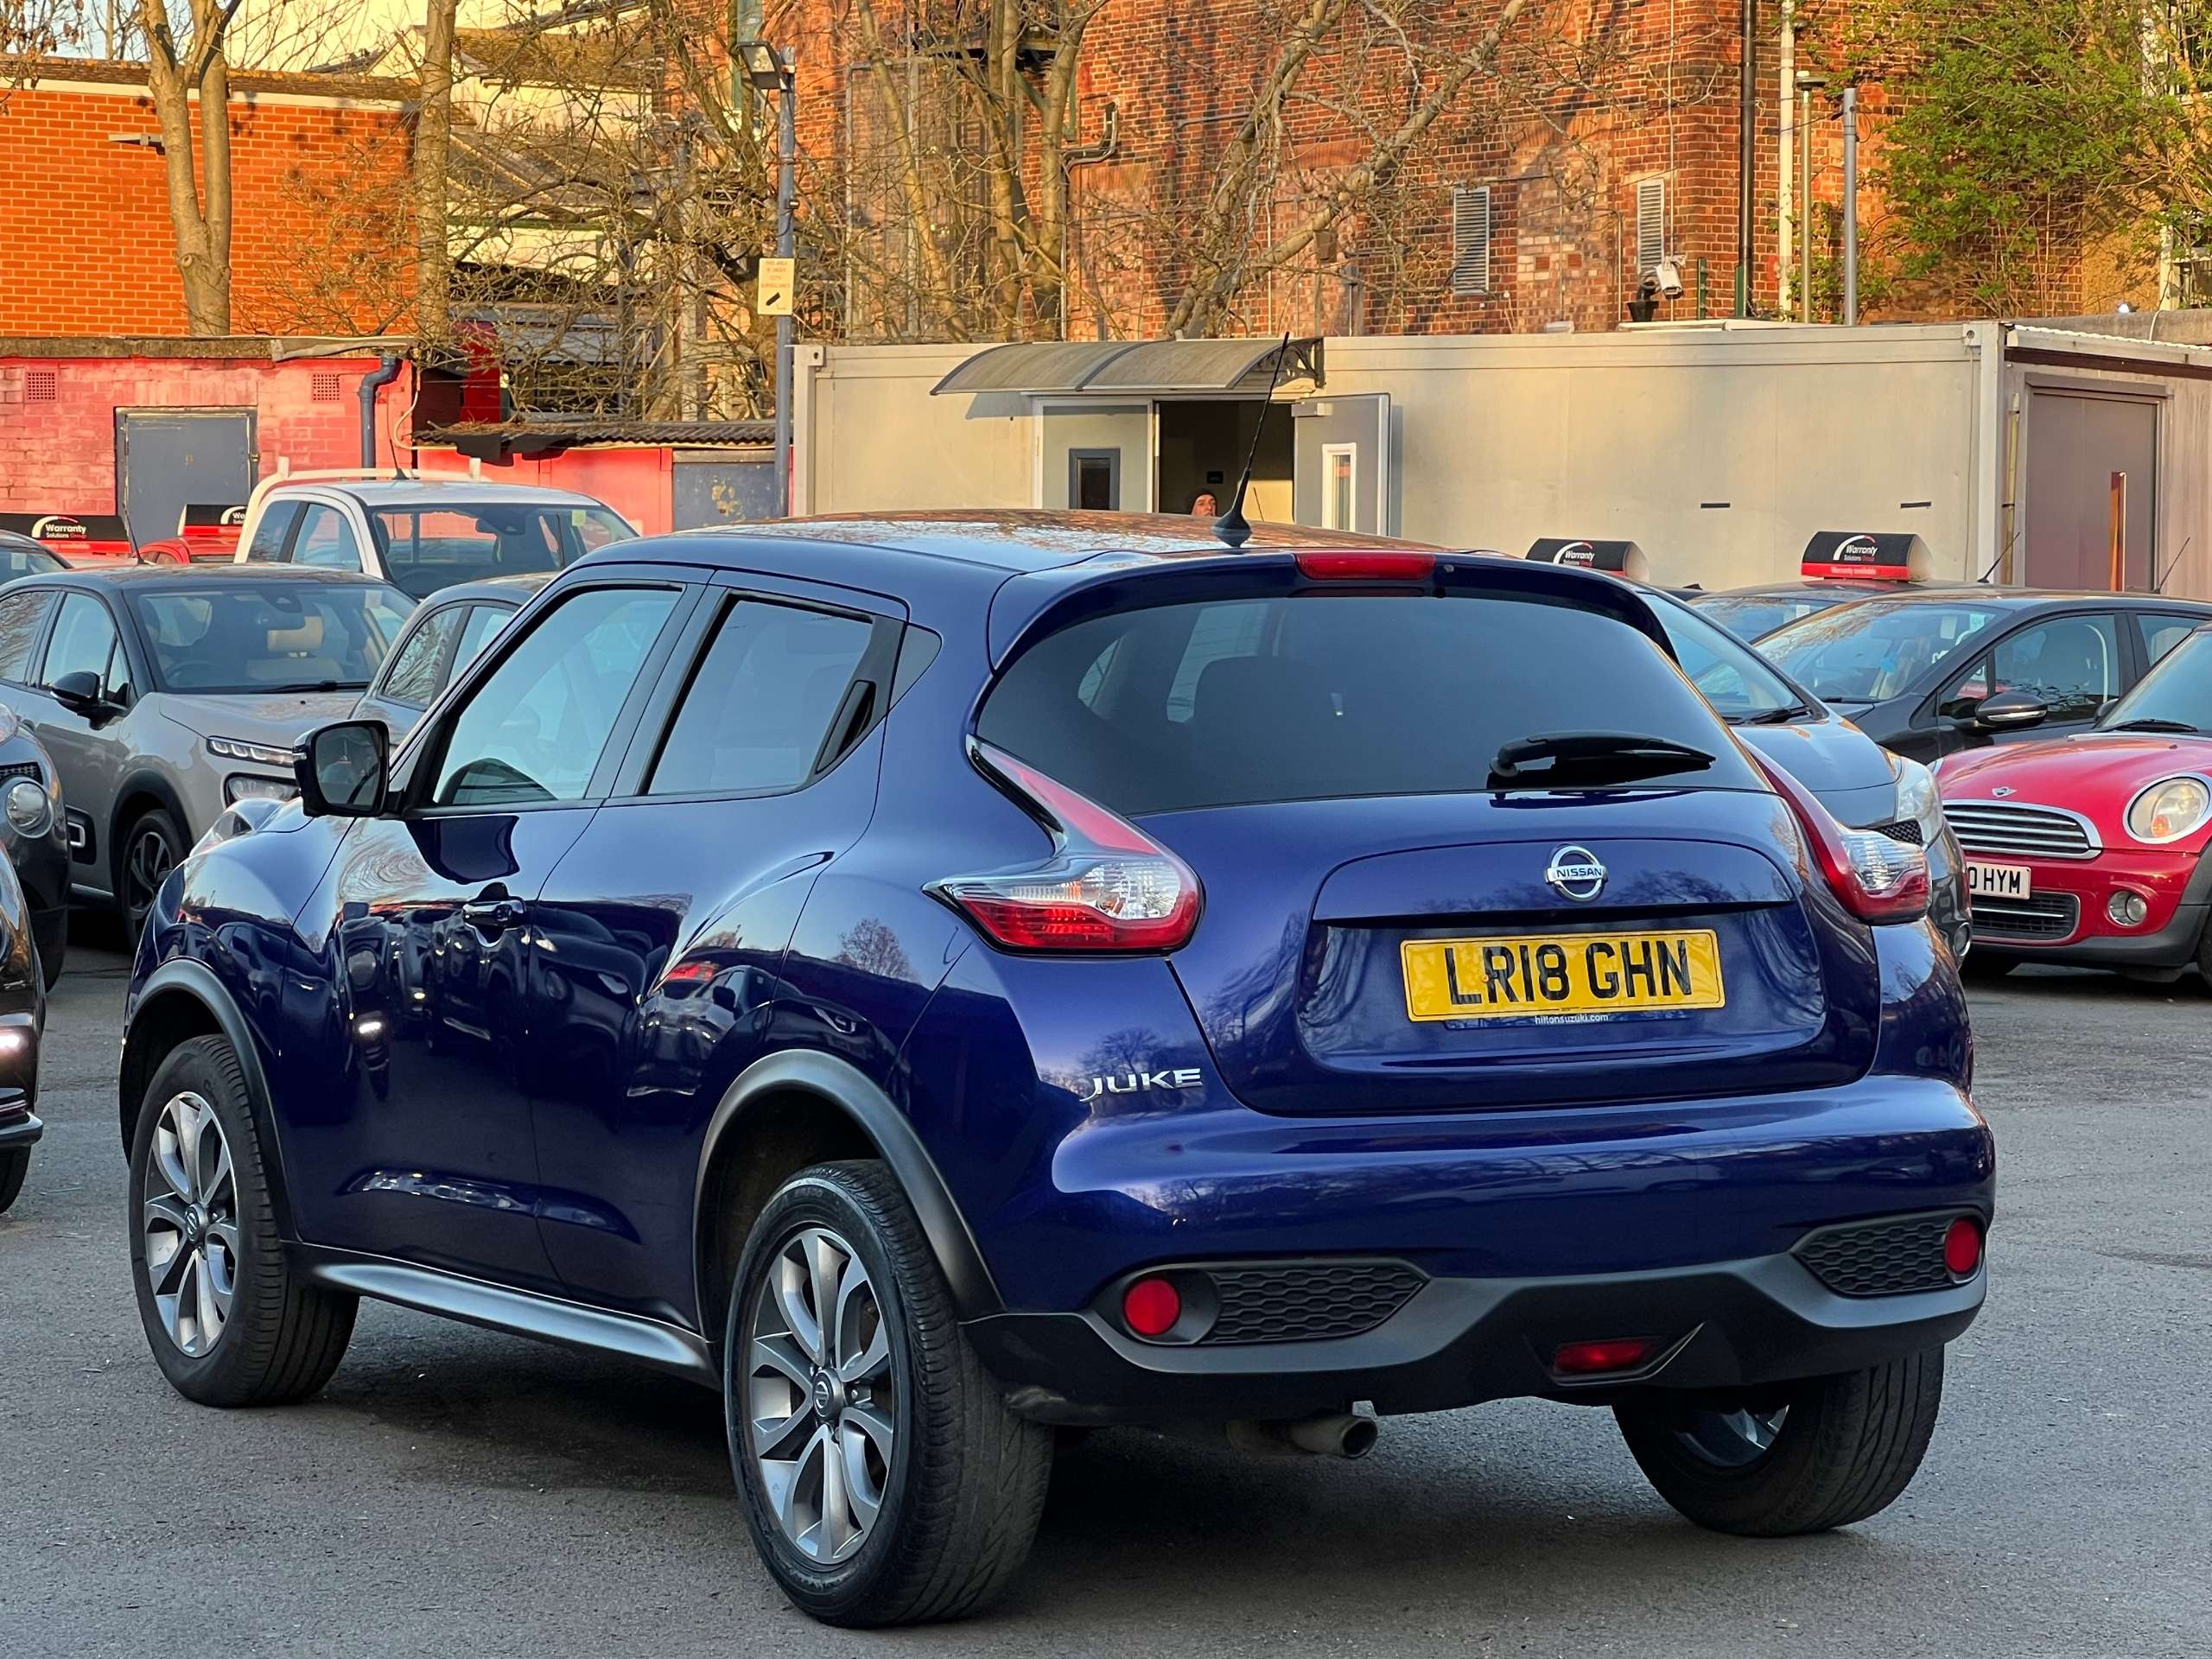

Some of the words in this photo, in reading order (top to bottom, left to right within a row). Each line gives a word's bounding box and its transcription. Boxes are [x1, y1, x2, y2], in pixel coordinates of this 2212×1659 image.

[45, 524, 86, 535] Warranty
[1565, 550, 1595, 562] Warranty
[1846, 544, 1878, 556] Warranty
[1556, 868, 1602, 877] NISSAN
[1984, 868, 2020, 893] HYM
[1445, 943, 1571, 1005] LR18
[1586, 939, 1693, 999] GHN
[1535, 1014, 1609, 1025] hiltonsuzuki.com
[1079, 1068, 1204, 1102] JUKE
